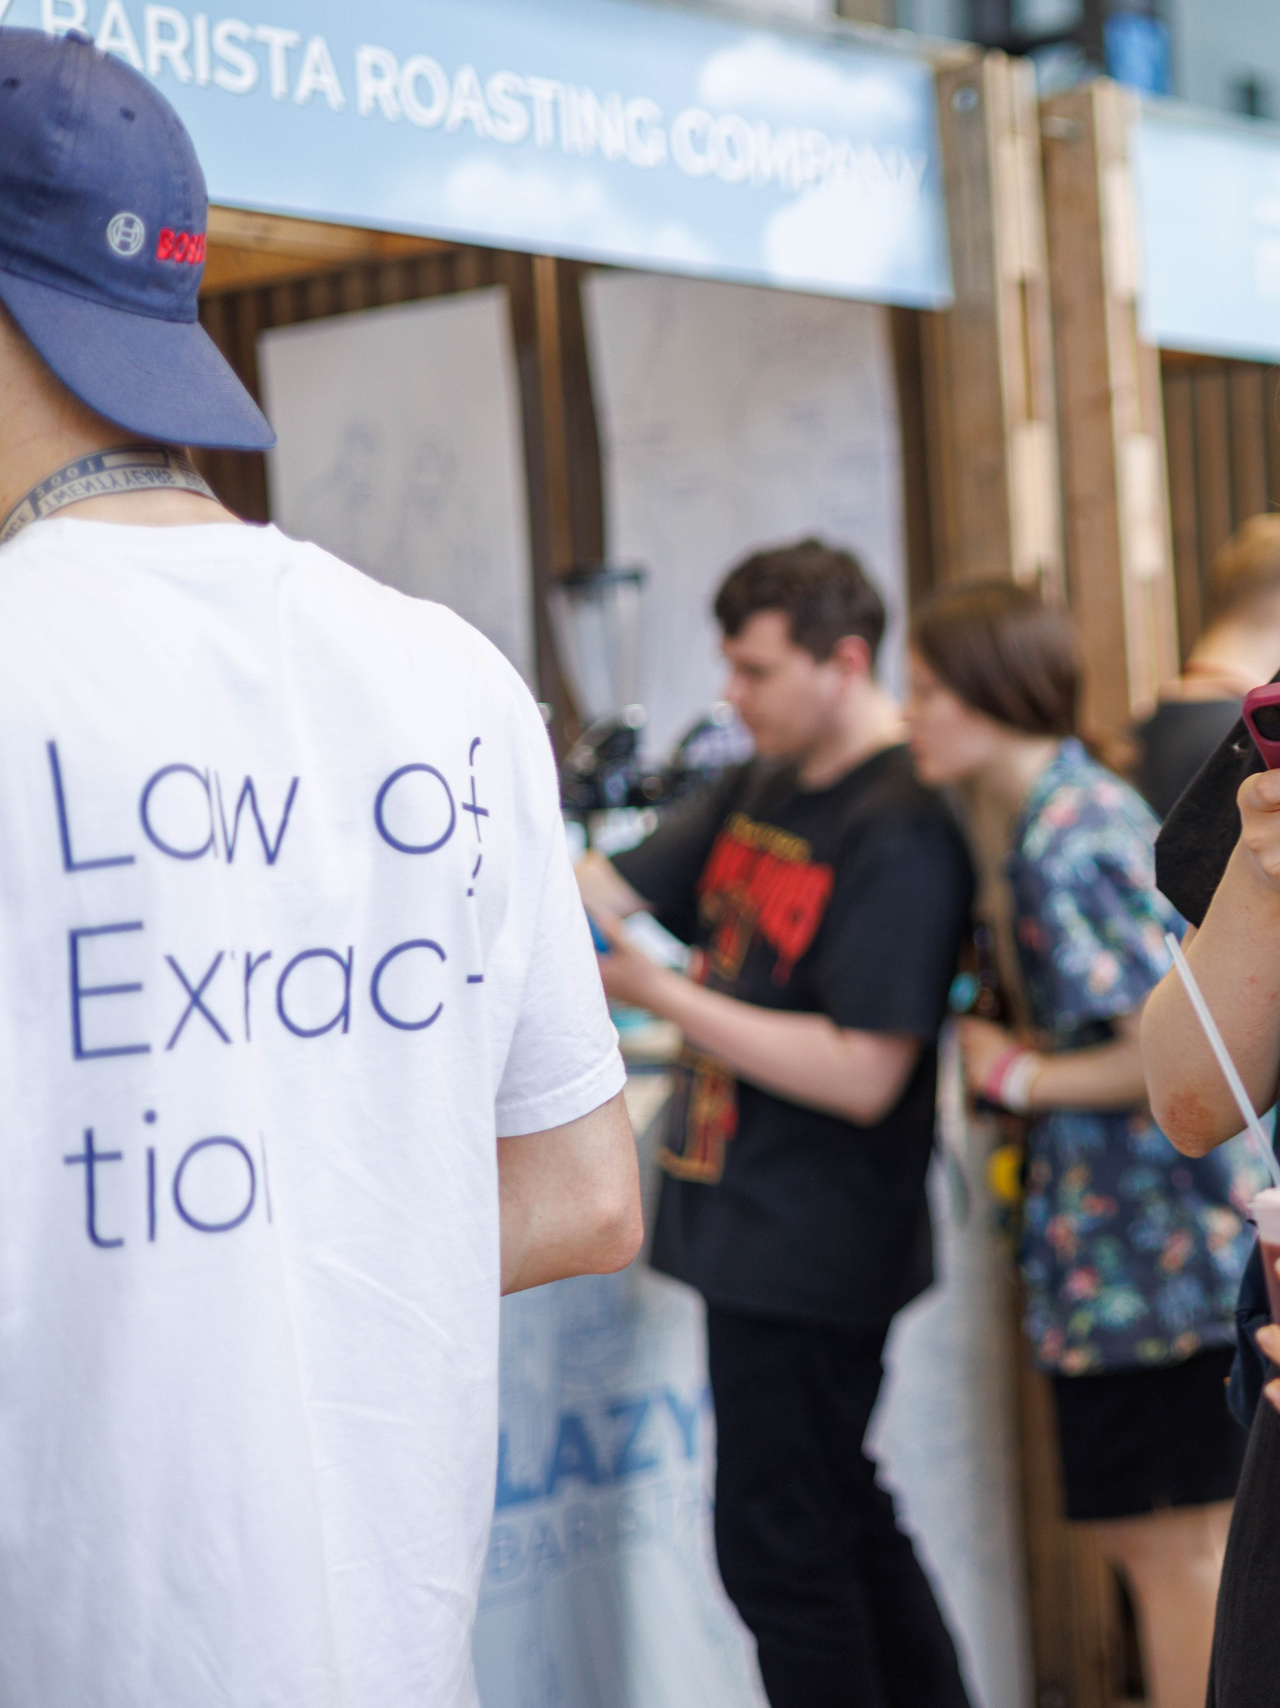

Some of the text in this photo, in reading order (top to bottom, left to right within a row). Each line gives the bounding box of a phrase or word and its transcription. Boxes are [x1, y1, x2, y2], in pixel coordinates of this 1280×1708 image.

[42, 0, 927, 202] BARISTA ROASTING COMPANY
[47, 739, 301, 874] Law
[63, 1109, 272, 1249] tio
